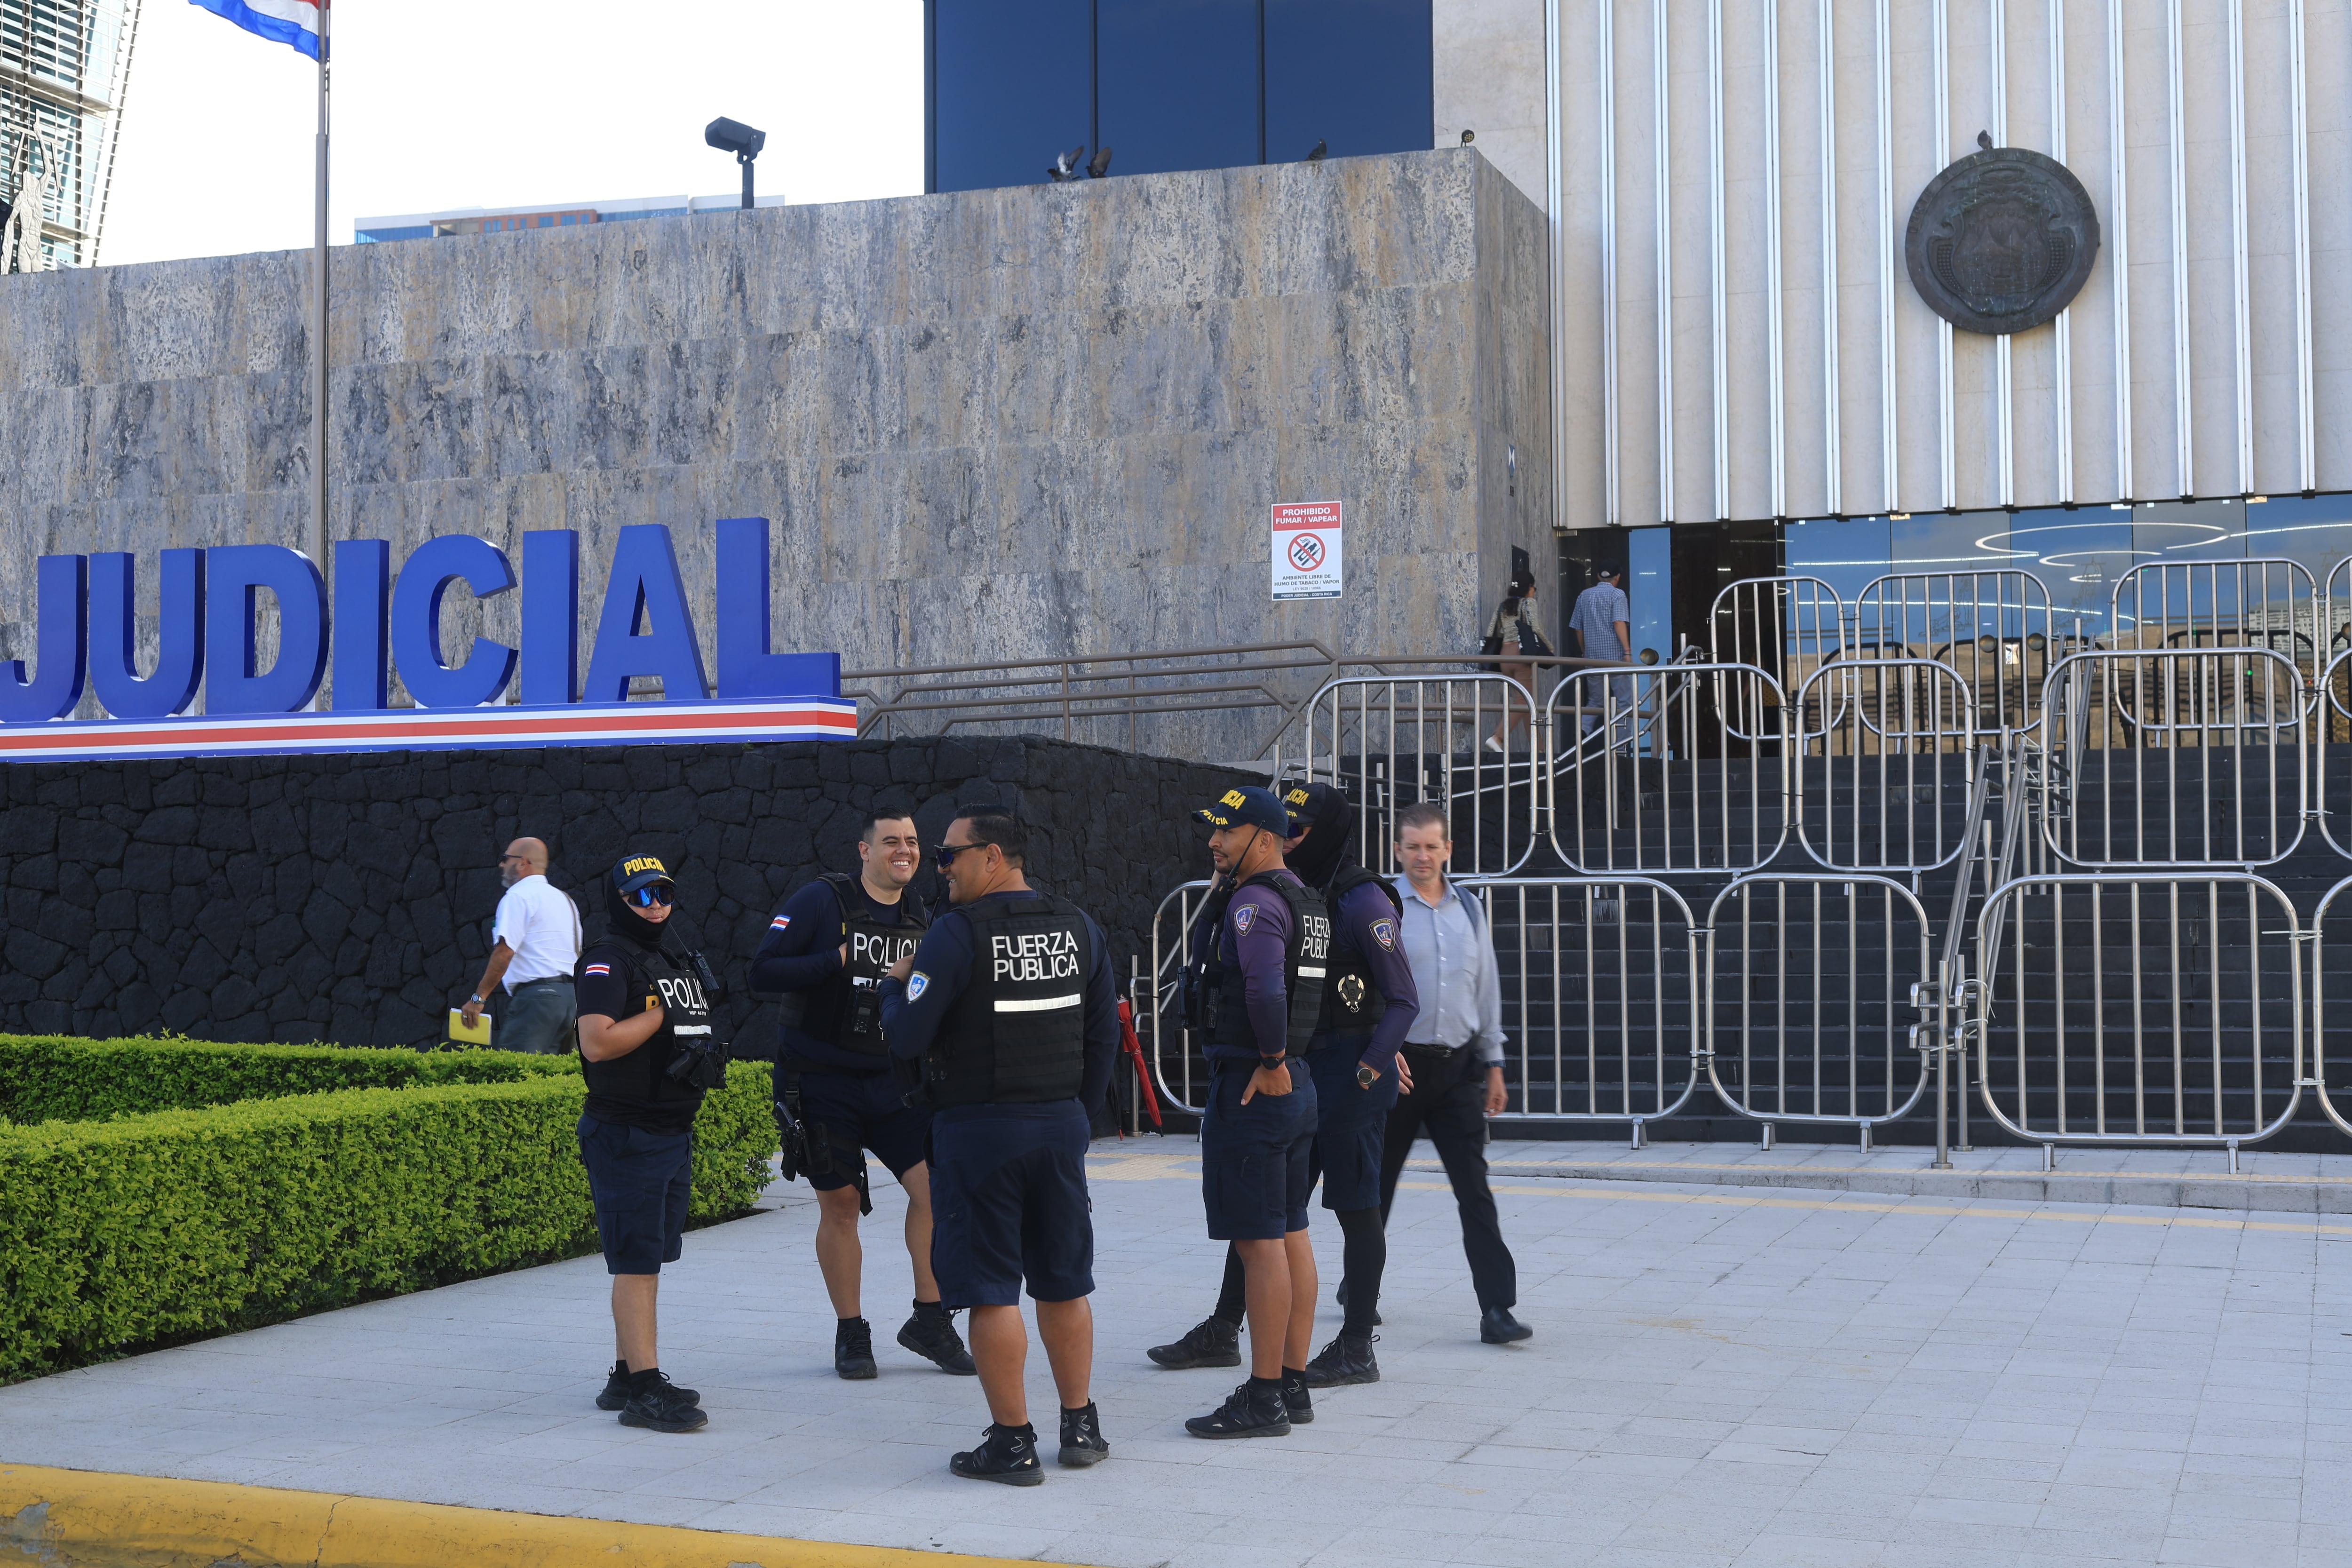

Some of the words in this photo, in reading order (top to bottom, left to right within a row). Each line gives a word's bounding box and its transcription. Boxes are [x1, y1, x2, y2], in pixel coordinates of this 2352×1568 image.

[1282, 507, 1331, 517] PROHIBIDO
[0, 517, 841, 723] JUDICIAL
[1199, 809, 1228, 825] POLICIA
[623, 857, 666, 876] POLICIA
[992, 931, 1079, 958] FUERZA
[1300, 936, 1330, 959] PUBLIC
[994, 953, 1079, 982] PUBLICA
